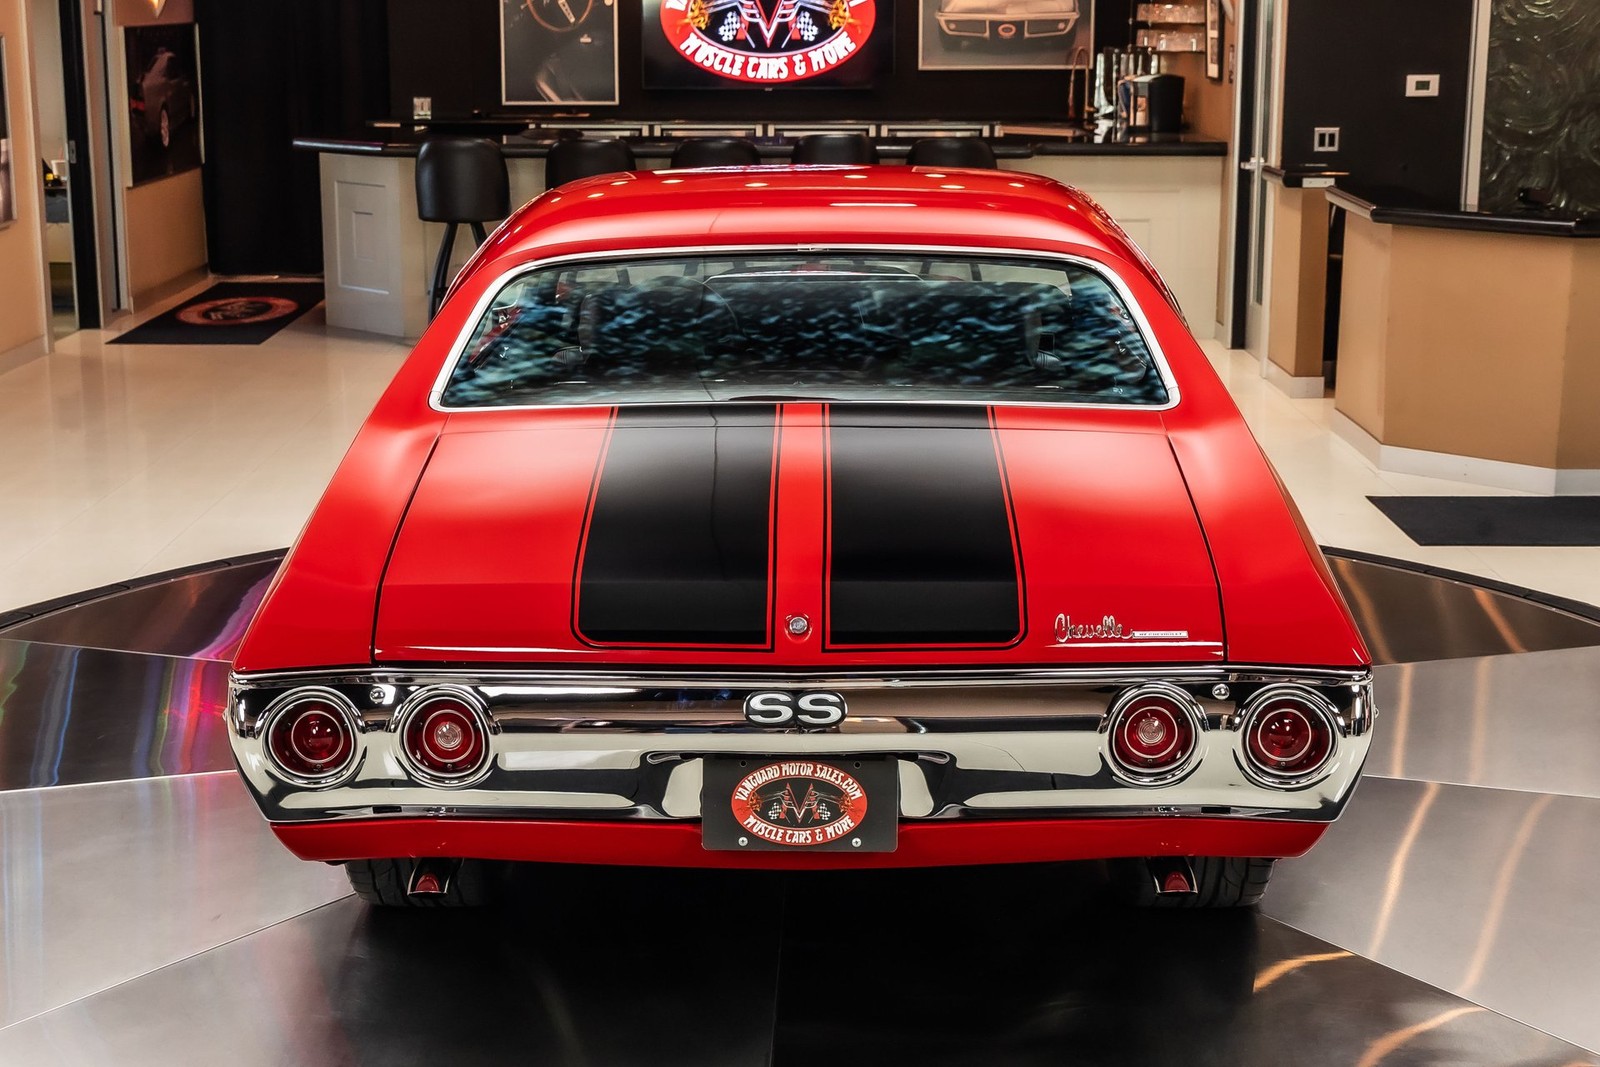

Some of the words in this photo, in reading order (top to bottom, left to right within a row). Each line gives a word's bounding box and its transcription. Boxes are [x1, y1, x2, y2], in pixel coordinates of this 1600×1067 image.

[679, 33, 746, 76] MUSCLE
[746, 56, 788, 80] CARS
[792, 55, 806, 76] &
[808, 31, 857, 72] MORE
[1054, 613, 1134, 642] Chevelle
[749, 693, 842, 724] SS
[735, 765, 780, 800] VANGUARD
[781, 762, 813, 777] MOTOR
[743, 815, 784, 841] MUSCLE
[785, 830, 812, 844] CARS
[815, 829, 824, 841] &
[825, 815, 855, 839] MORE
